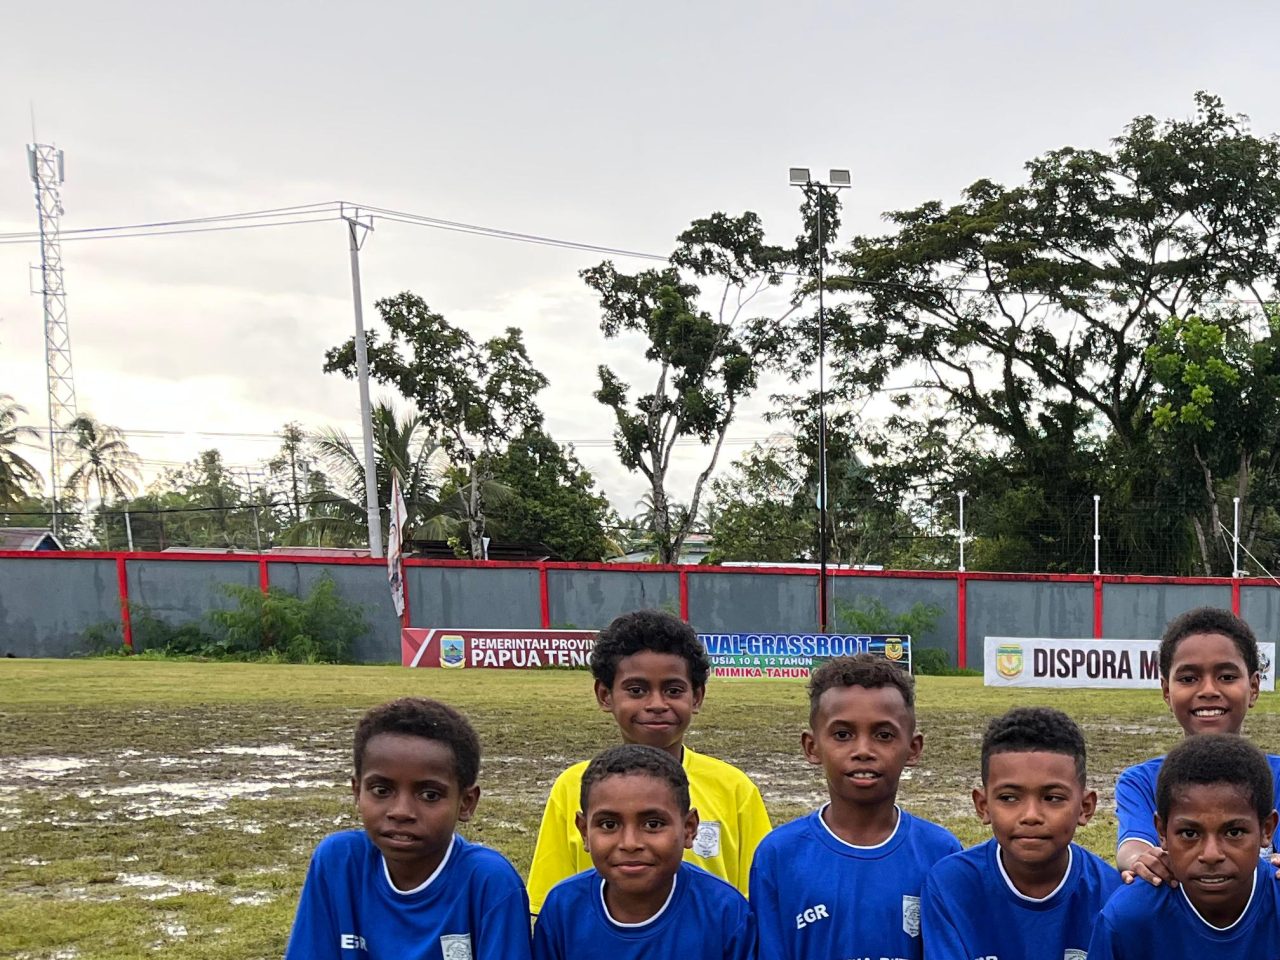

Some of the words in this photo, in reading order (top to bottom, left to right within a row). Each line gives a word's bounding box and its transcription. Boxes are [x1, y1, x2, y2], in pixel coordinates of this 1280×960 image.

[471, 638, 549, 650] PEMERINTAH
[551, 639, 599, 651] PROVIN
[471, 650, 542, 667] PAPUA
[712, 657, 736, 665] USIA
[738, 657, 751, 665] 10
[753, 657, 761, 665] &
[764, 657, 776, 665] 12
[779, 658, 813, 666] TAHUN
[1033, 648, 1132, 679] DISPORA
[715, 667, 762, 677] MIMIKA
[766, 668, 809, 678] TAHUN
[796, 904, 829, 929] EGR
